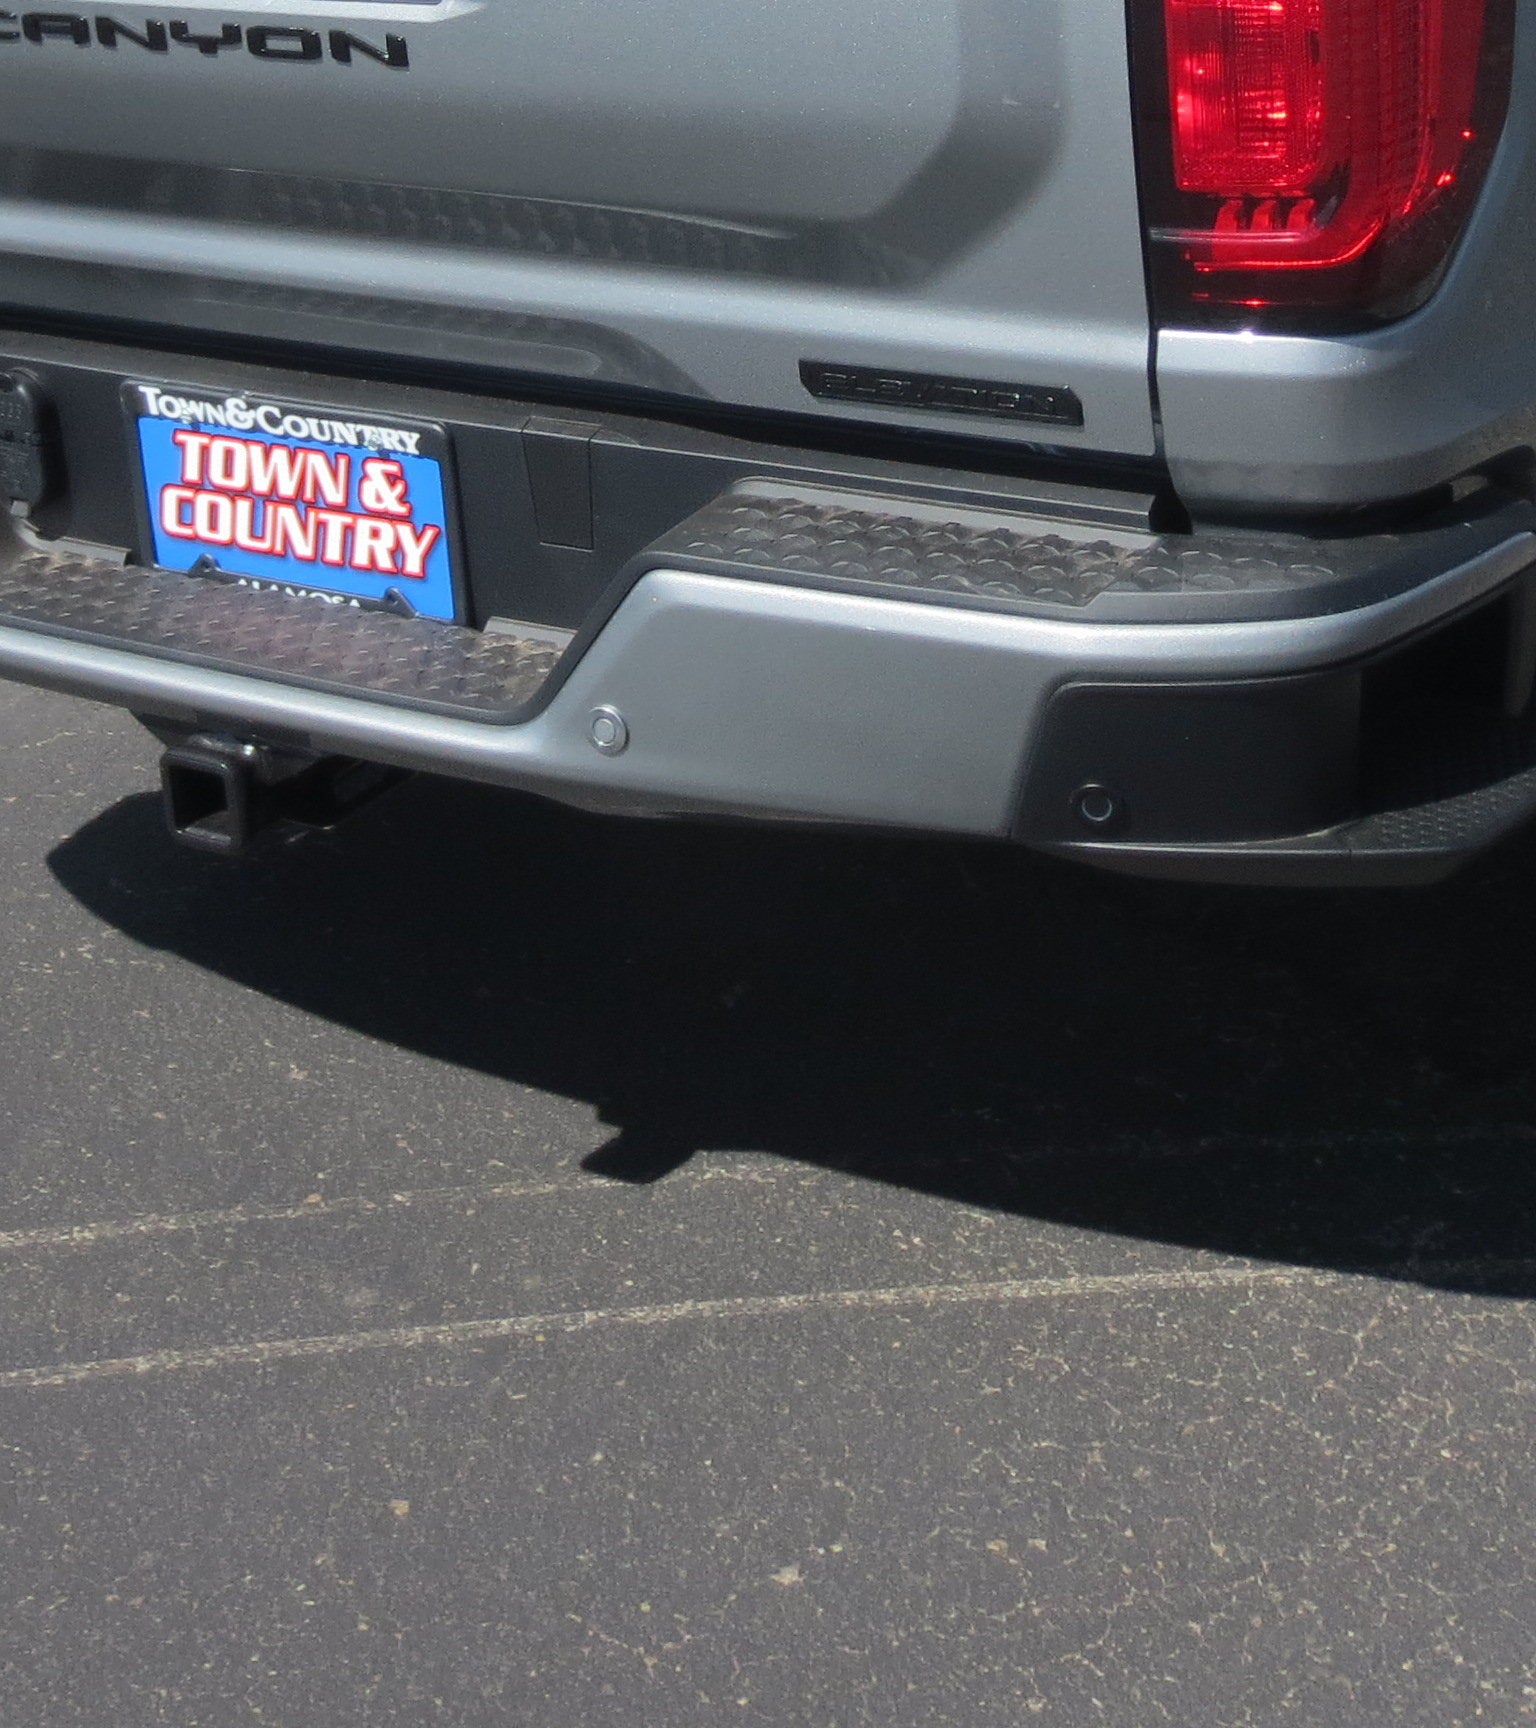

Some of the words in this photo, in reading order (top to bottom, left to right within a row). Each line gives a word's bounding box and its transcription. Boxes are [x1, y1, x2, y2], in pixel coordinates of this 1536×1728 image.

[819, 371, 1060, 417] ELEVATION
[174, 429, 350, 508] TOWN
[359, 457, 412, 517] &
[161, 483, 441, 579] COUNTRY
